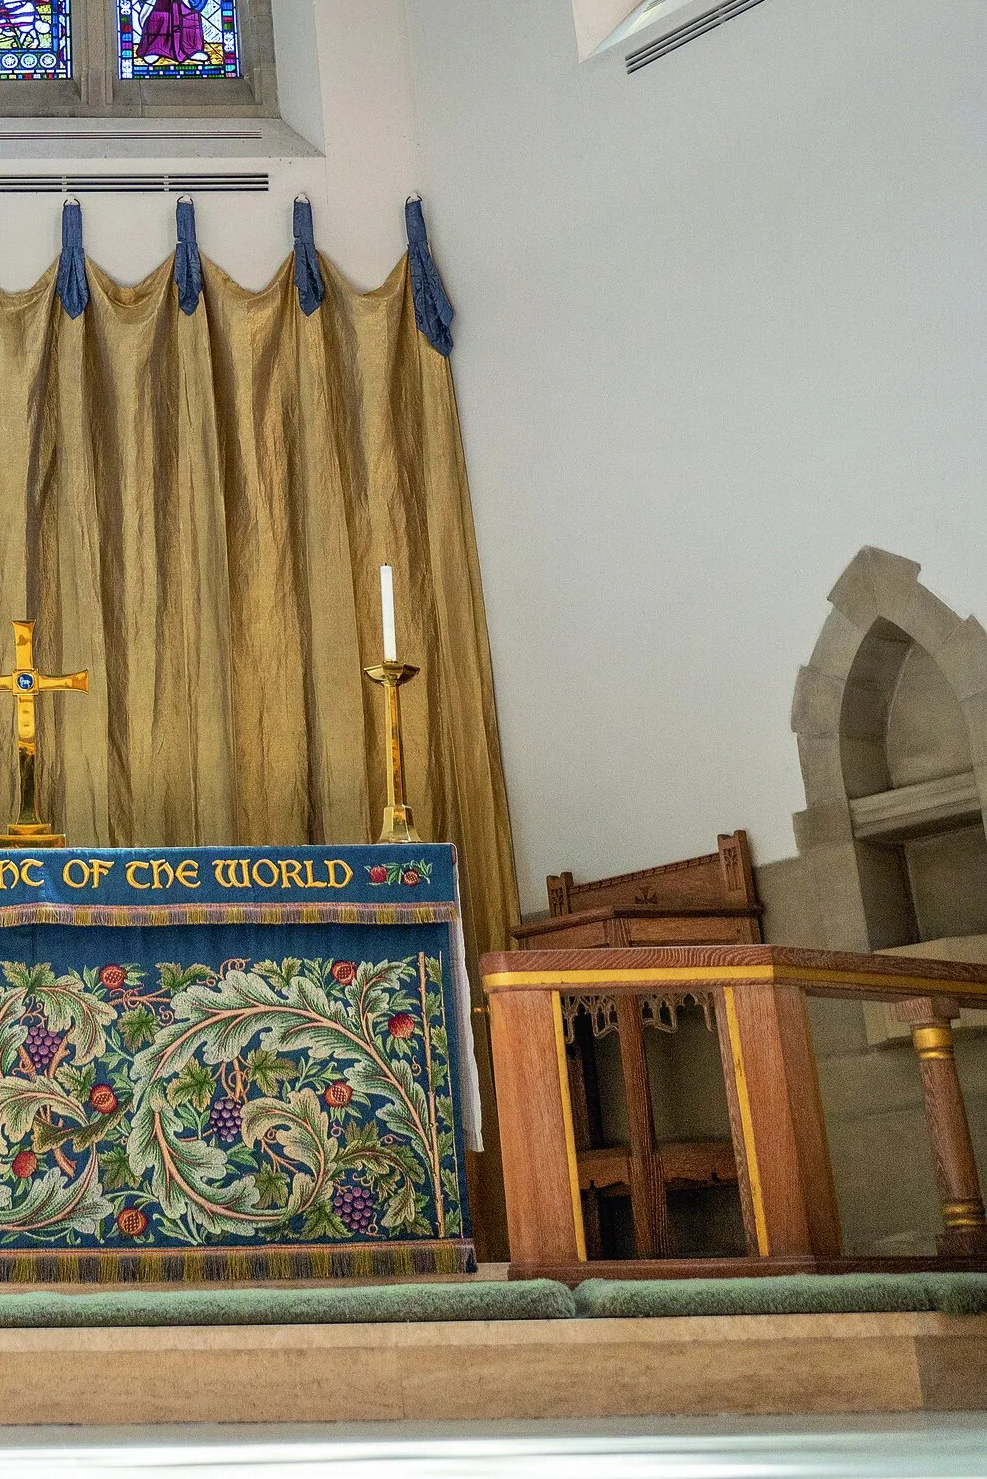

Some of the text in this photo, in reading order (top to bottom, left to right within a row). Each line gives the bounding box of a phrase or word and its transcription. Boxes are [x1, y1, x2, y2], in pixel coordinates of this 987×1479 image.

[62, 859, 114, 889] OF
[125, 859, 201, 890] THE
[212, 858, 354, 889] WORLD
